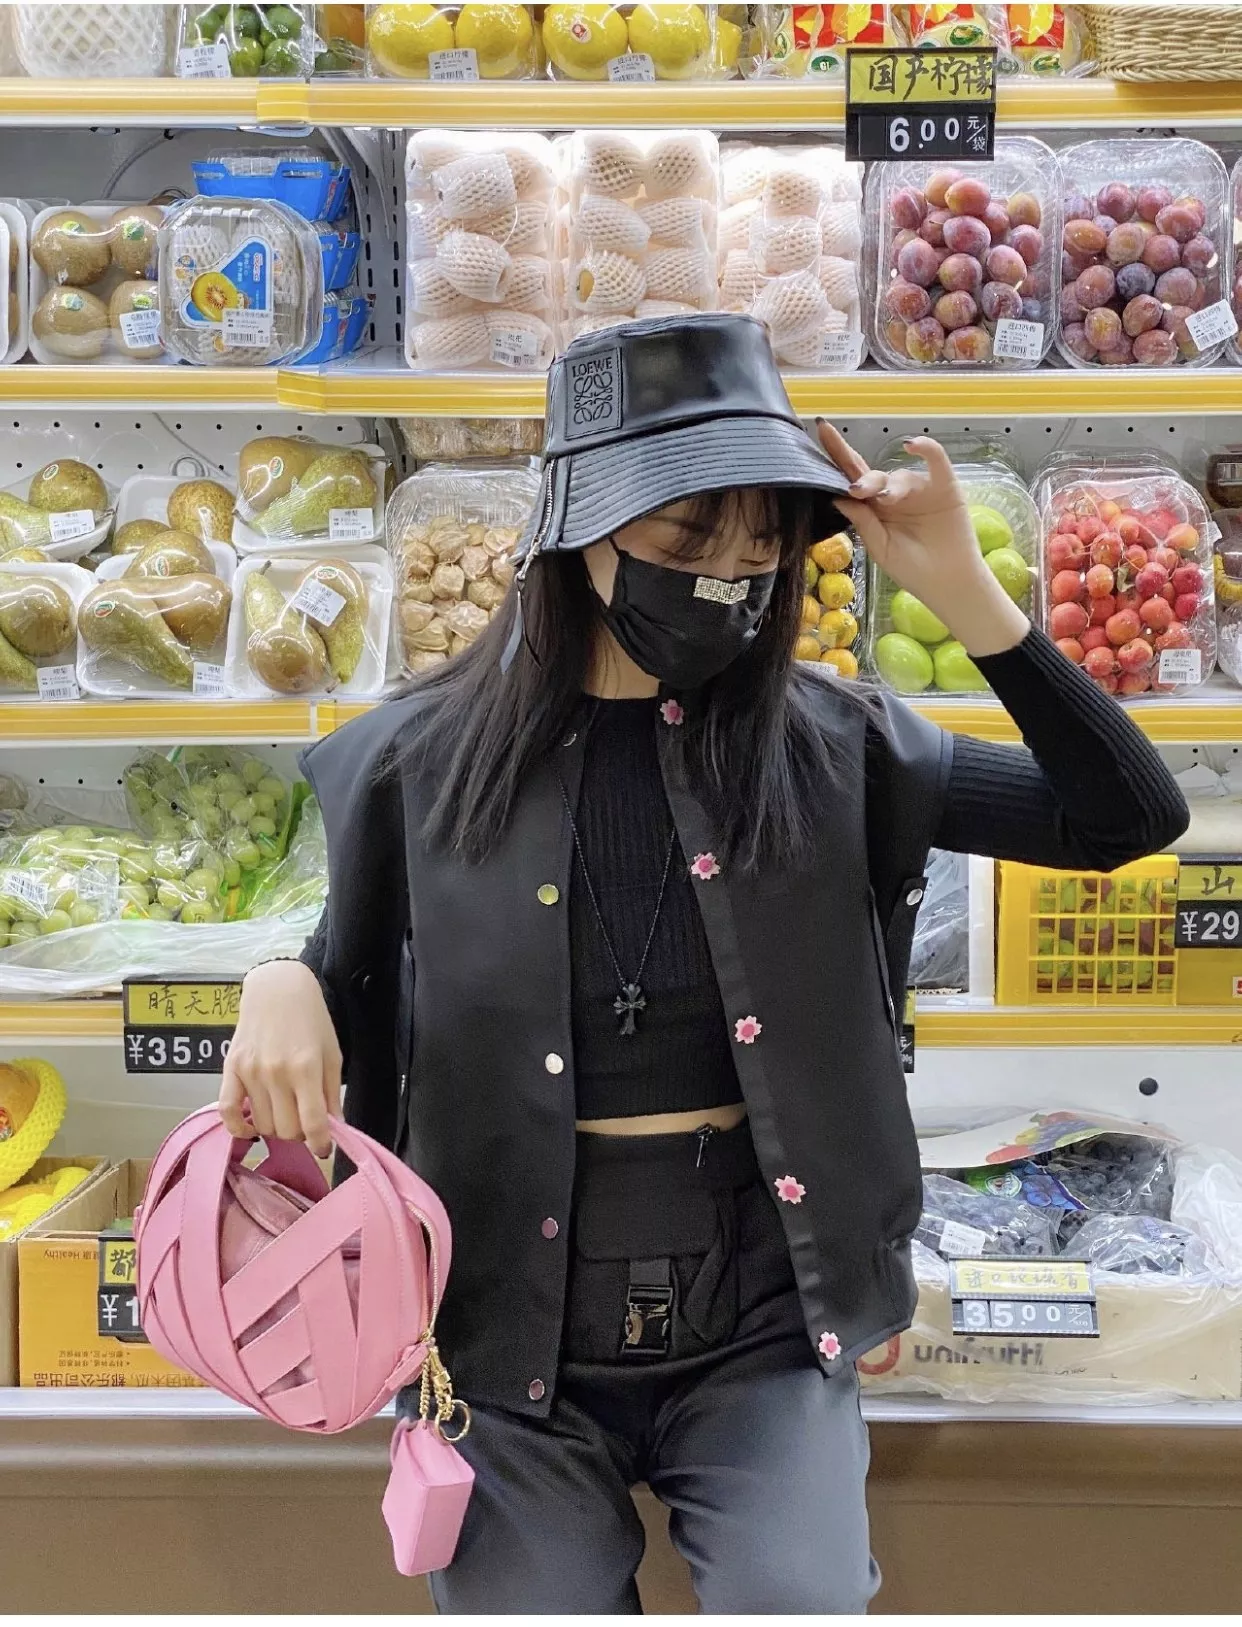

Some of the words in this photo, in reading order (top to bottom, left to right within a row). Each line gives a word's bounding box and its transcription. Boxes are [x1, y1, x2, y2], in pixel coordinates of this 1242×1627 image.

[869, 52, 994, 101] 国产柠檬
[889, 117, 960, 152] 6.00
[571, 356, 613, 378] LOEWE
[1200, 865, 1236, 895] 山
[1179, 910, 1240, 942] ¥29
[965, 1301, 1062, 1328] 35.00
